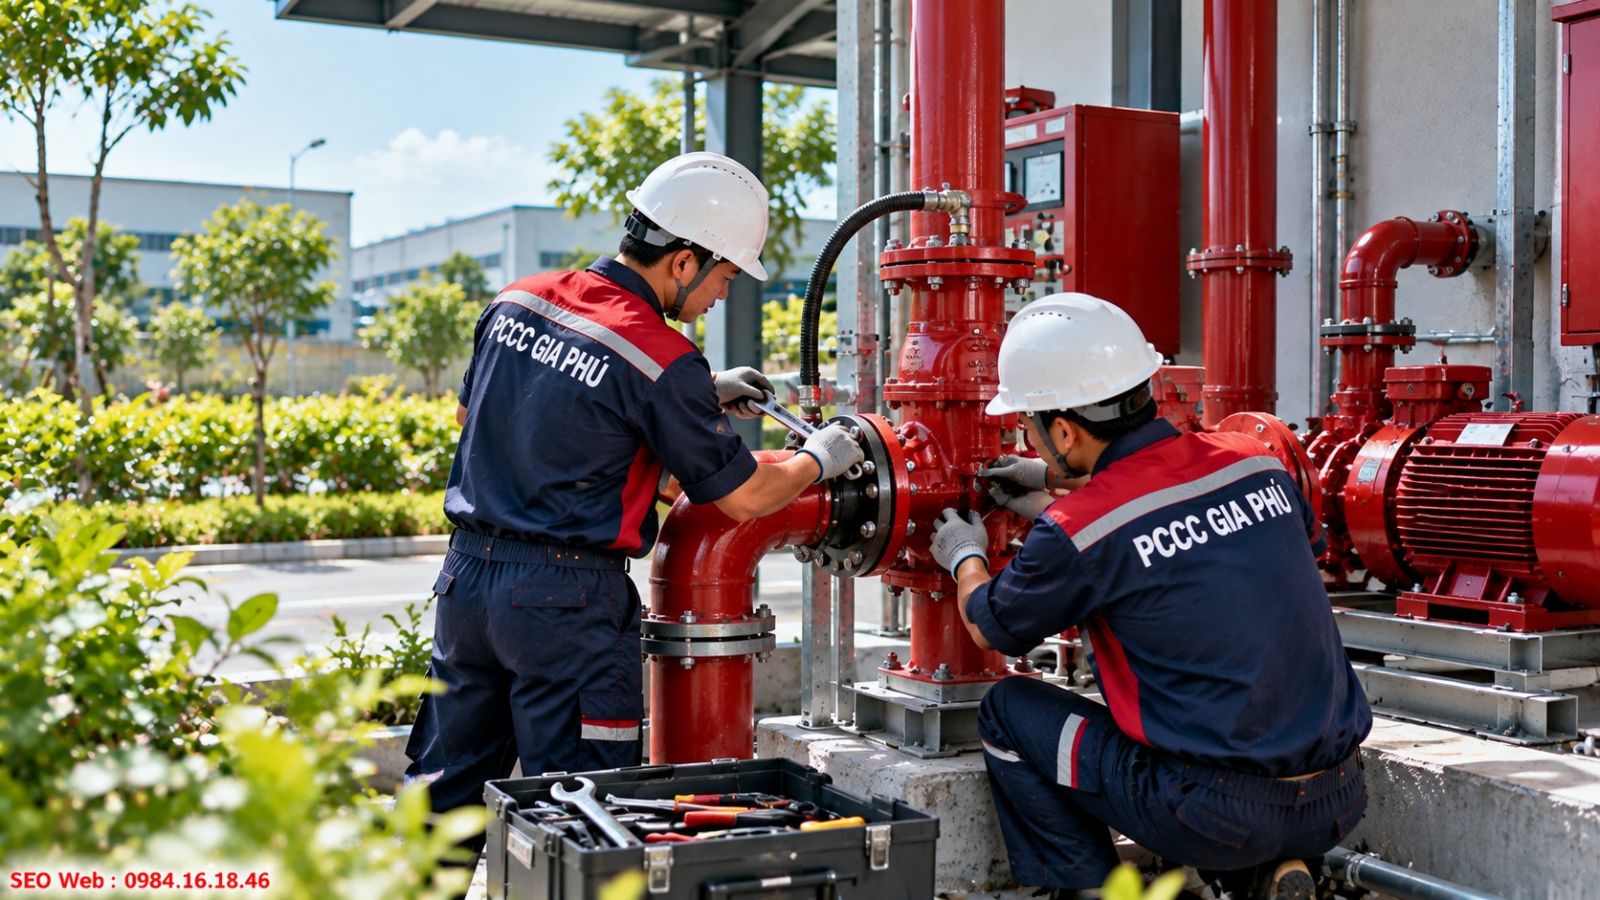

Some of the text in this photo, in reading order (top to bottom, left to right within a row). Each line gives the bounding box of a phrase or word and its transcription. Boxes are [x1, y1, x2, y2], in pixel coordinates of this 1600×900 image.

[488, 314, 610, 388] PCCC GIA PHÚ
[1132, 478, 1292, 568] PCCC GIA PHÚ
